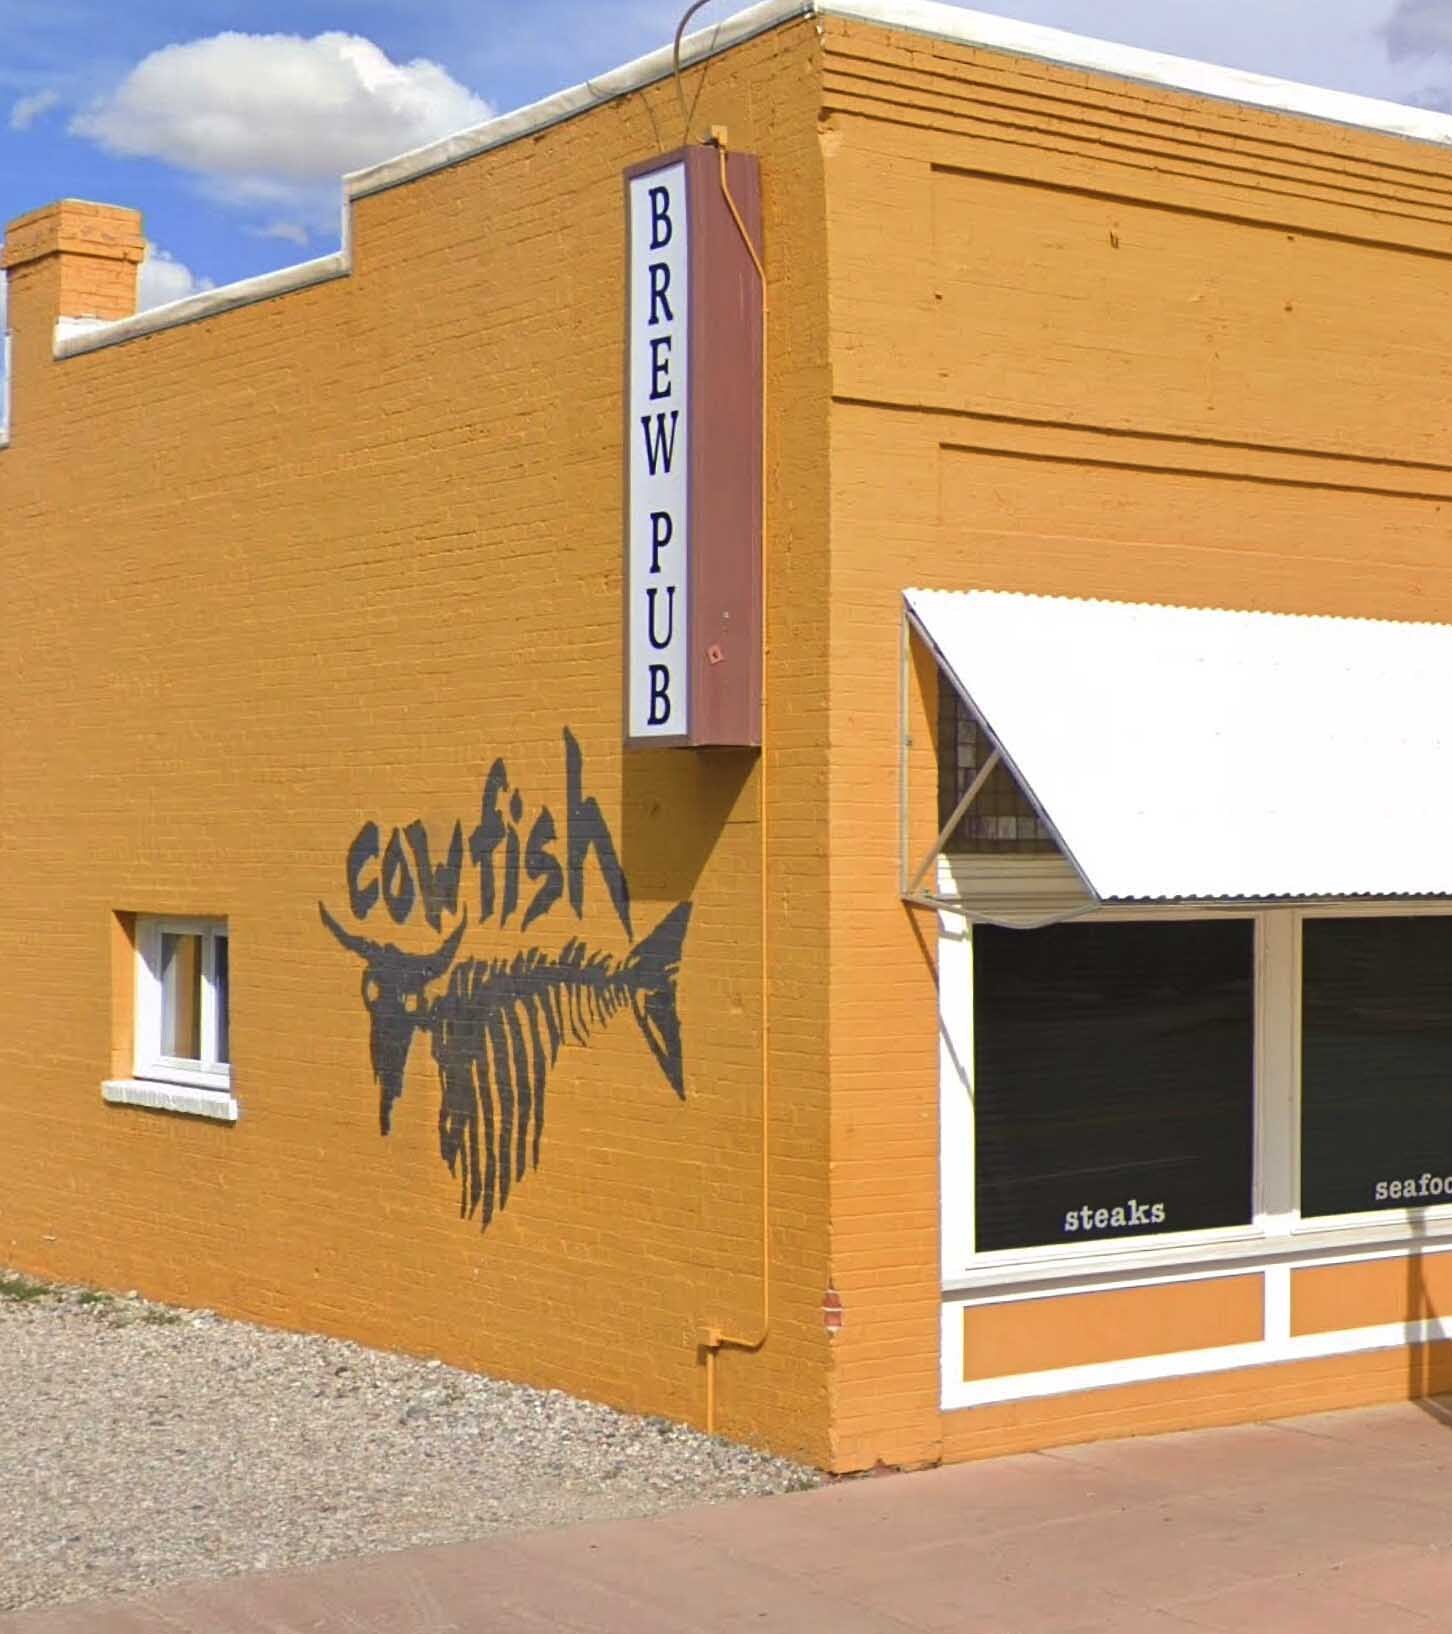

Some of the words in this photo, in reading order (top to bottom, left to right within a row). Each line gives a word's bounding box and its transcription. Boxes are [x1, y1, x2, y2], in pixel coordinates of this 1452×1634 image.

[641, 185, 679, 476] BREW
[646, 511, 675, 726] PUB
[1064, 1199, 1166, 1231] steaks
